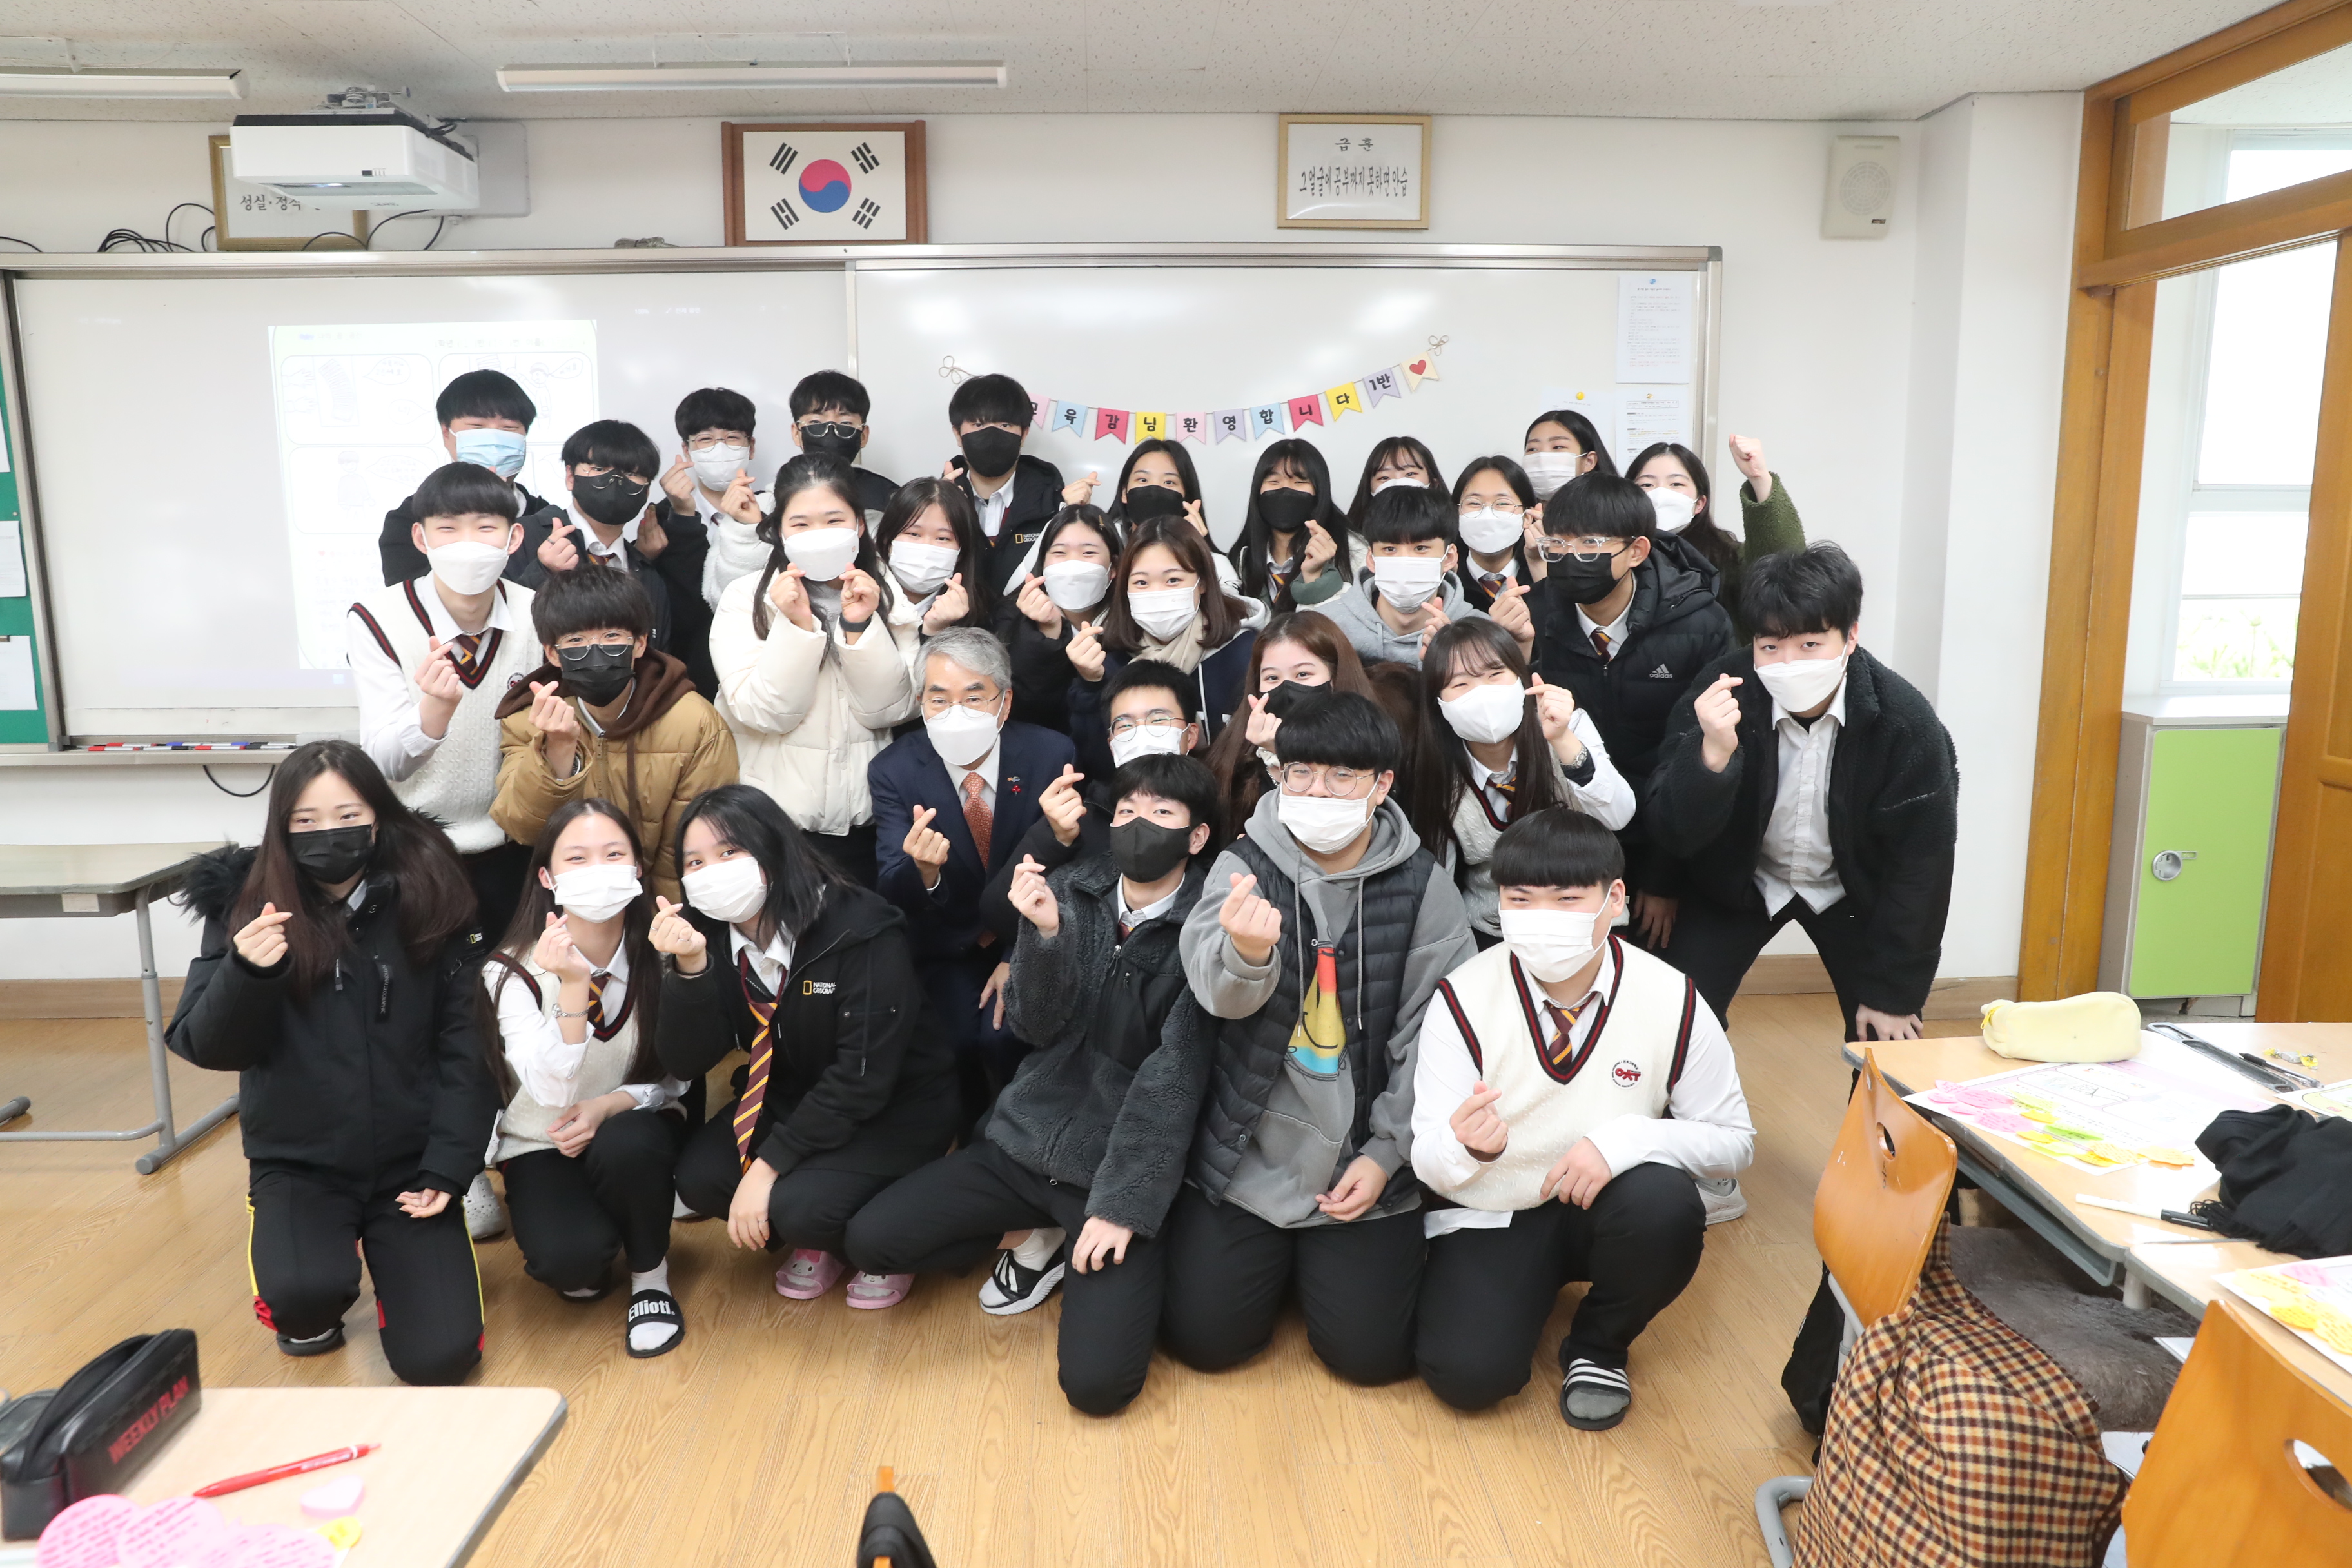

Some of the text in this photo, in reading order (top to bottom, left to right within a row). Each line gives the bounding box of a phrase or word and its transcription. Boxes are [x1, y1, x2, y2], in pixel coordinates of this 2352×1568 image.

[1368, 373, 1392, 391] 1반
[108, 1375, 190, 1464] WEEKLY PLAN
